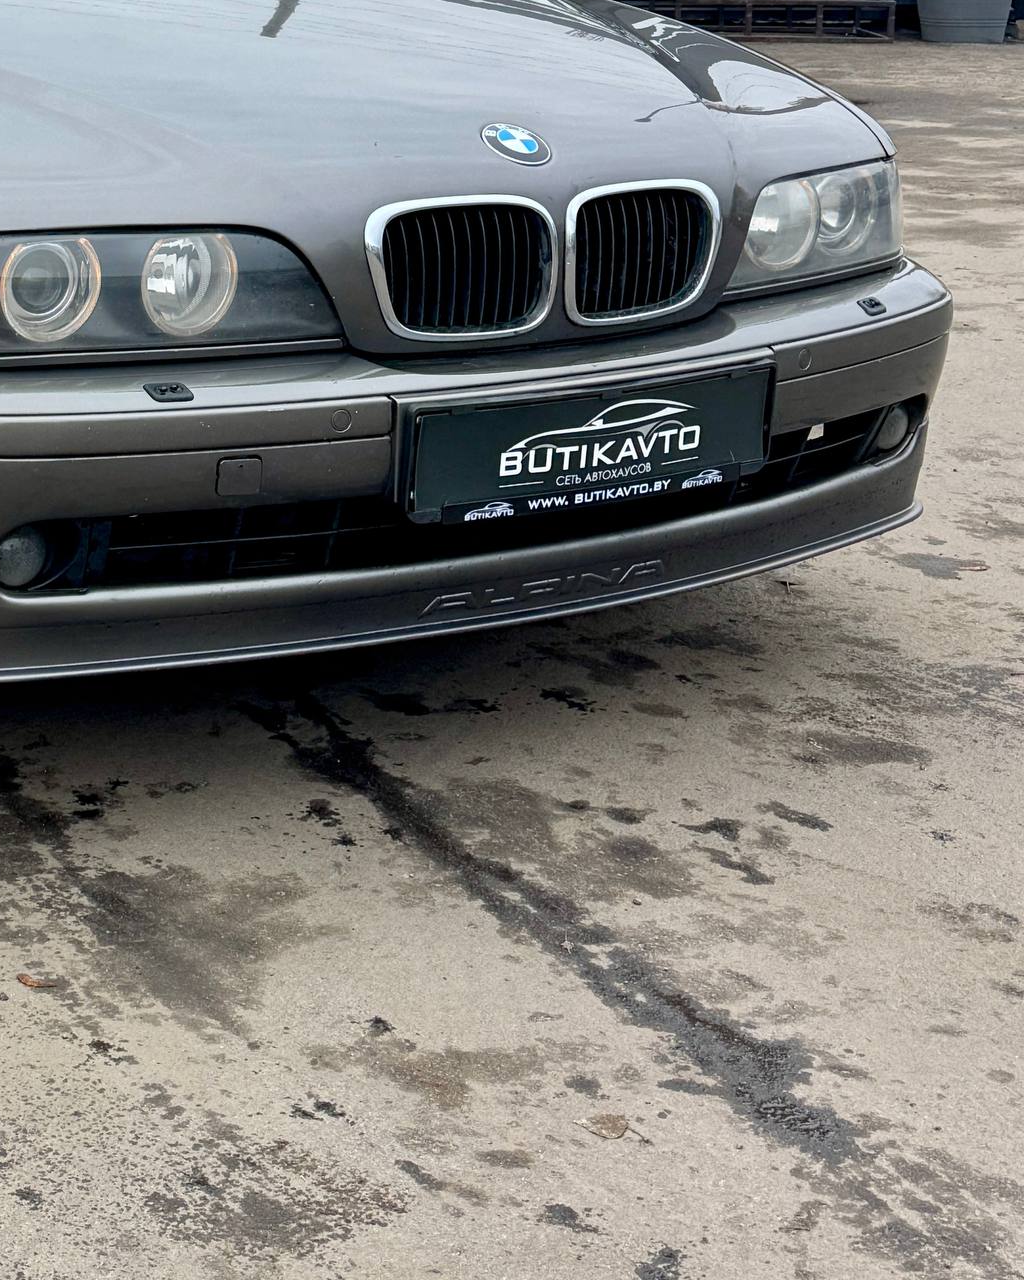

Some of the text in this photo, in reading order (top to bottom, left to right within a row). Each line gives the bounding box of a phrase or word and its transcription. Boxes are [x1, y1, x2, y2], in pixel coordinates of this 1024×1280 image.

[499, 424, 701, 477] BUTIKAVTO
[556, 463, 652, 487] СЕТЬ АВТОХАУСОВ
[681, 475, 723, 490] BUTIKAVTO
[528, 479, 671, 511] WWW. BUTIKAVTO.BY
[464, 507, 514, 522] BUTIKAVTO
[418, 559, 664, 618] ALPINA
